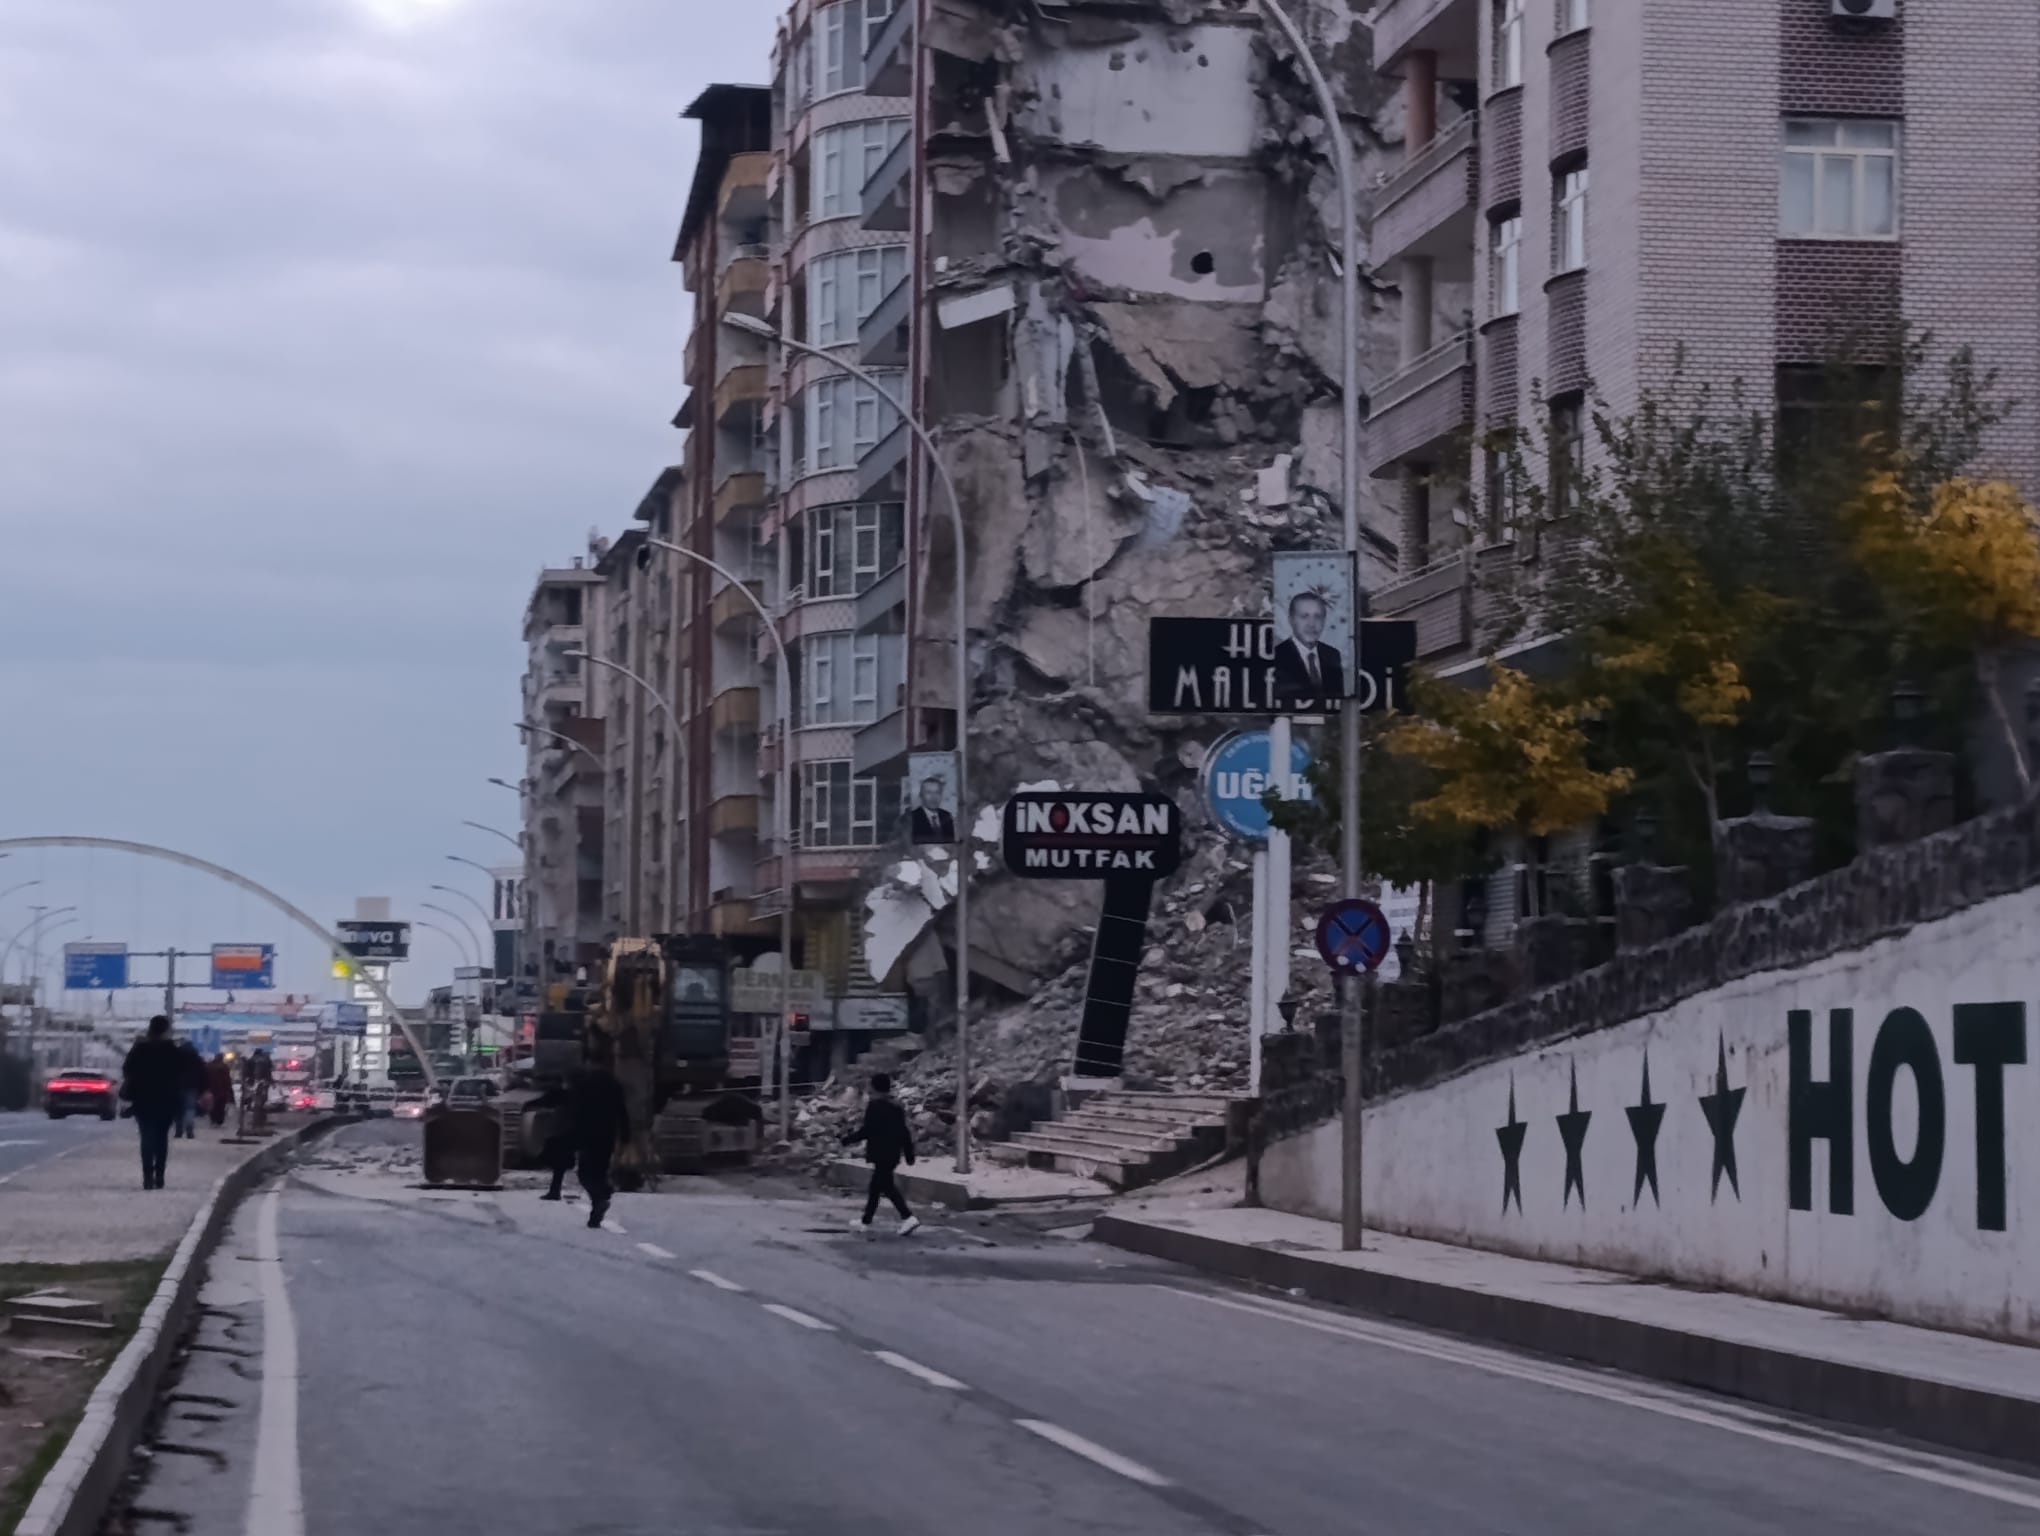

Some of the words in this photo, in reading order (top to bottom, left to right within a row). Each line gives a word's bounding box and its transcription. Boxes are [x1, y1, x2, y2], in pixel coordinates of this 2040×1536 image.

[1216, 767, 1312, 801] UĞR
[1024, 848, 1156, 870] MUTFAK
[1787, 1001, 2028, 1232] HOT
